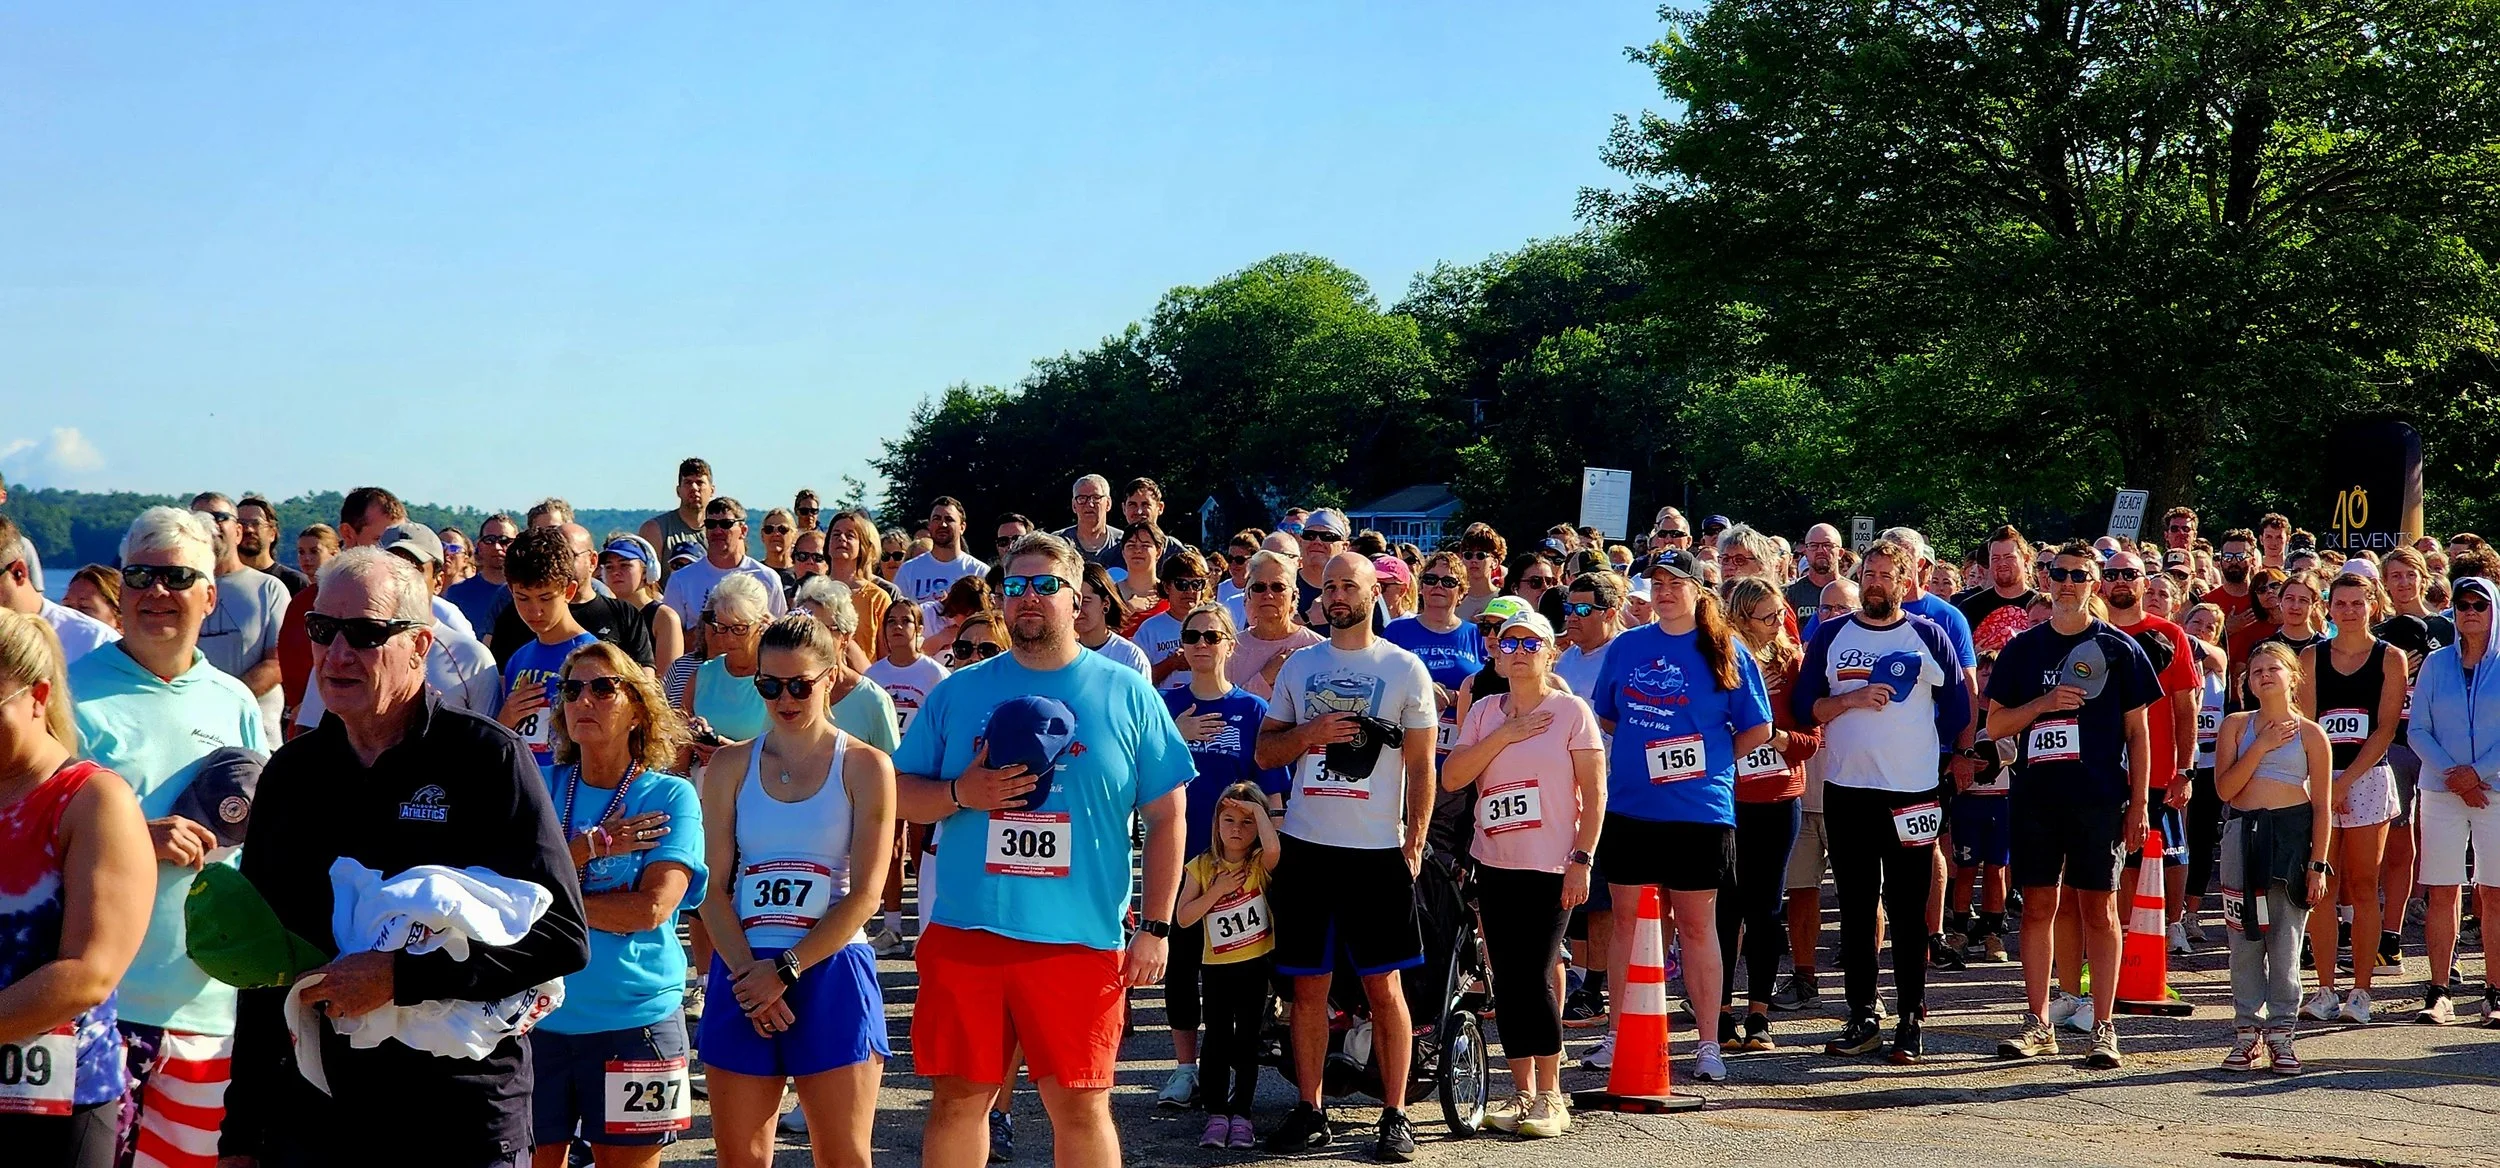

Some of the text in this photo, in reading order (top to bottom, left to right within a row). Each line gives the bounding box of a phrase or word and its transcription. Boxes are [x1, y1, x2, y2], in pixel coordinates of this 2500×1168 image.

[2118, 495, 2142, 510] BEACH
[1859, 522, 1867, 531] NO
[2112, 514, 2139, 529] CLOSED
[1854, 532, 1871, 541] DOGS
[2349, 532, 2414, 549] EVENTS
[915, 578, 949, 600] US
[1411, 647, 1476, 665] EW ENGLAND
[1836, 648, 1875, 669] Be
[2198, 714, 2215, 729] 96
[2325, 717, 2359, 734] 209
[2034, 730, 2068, 751] 485
[1657, 747, 1697, 771] 156
[1746, 747, 1778, 768] 587
[401, 805, 446, 820] ATHLETICS
[1489, 795, 1528, 821] 315
[1905, 813, 1938, 836] 586
[1001, 828, 1057, 859] 308
[753, 877, 813, 908] 367
[2225, 899, 2243, 920] 59
[1217, 905, 1261, 938] 314
[623, 1079, 682, 1113] 237
